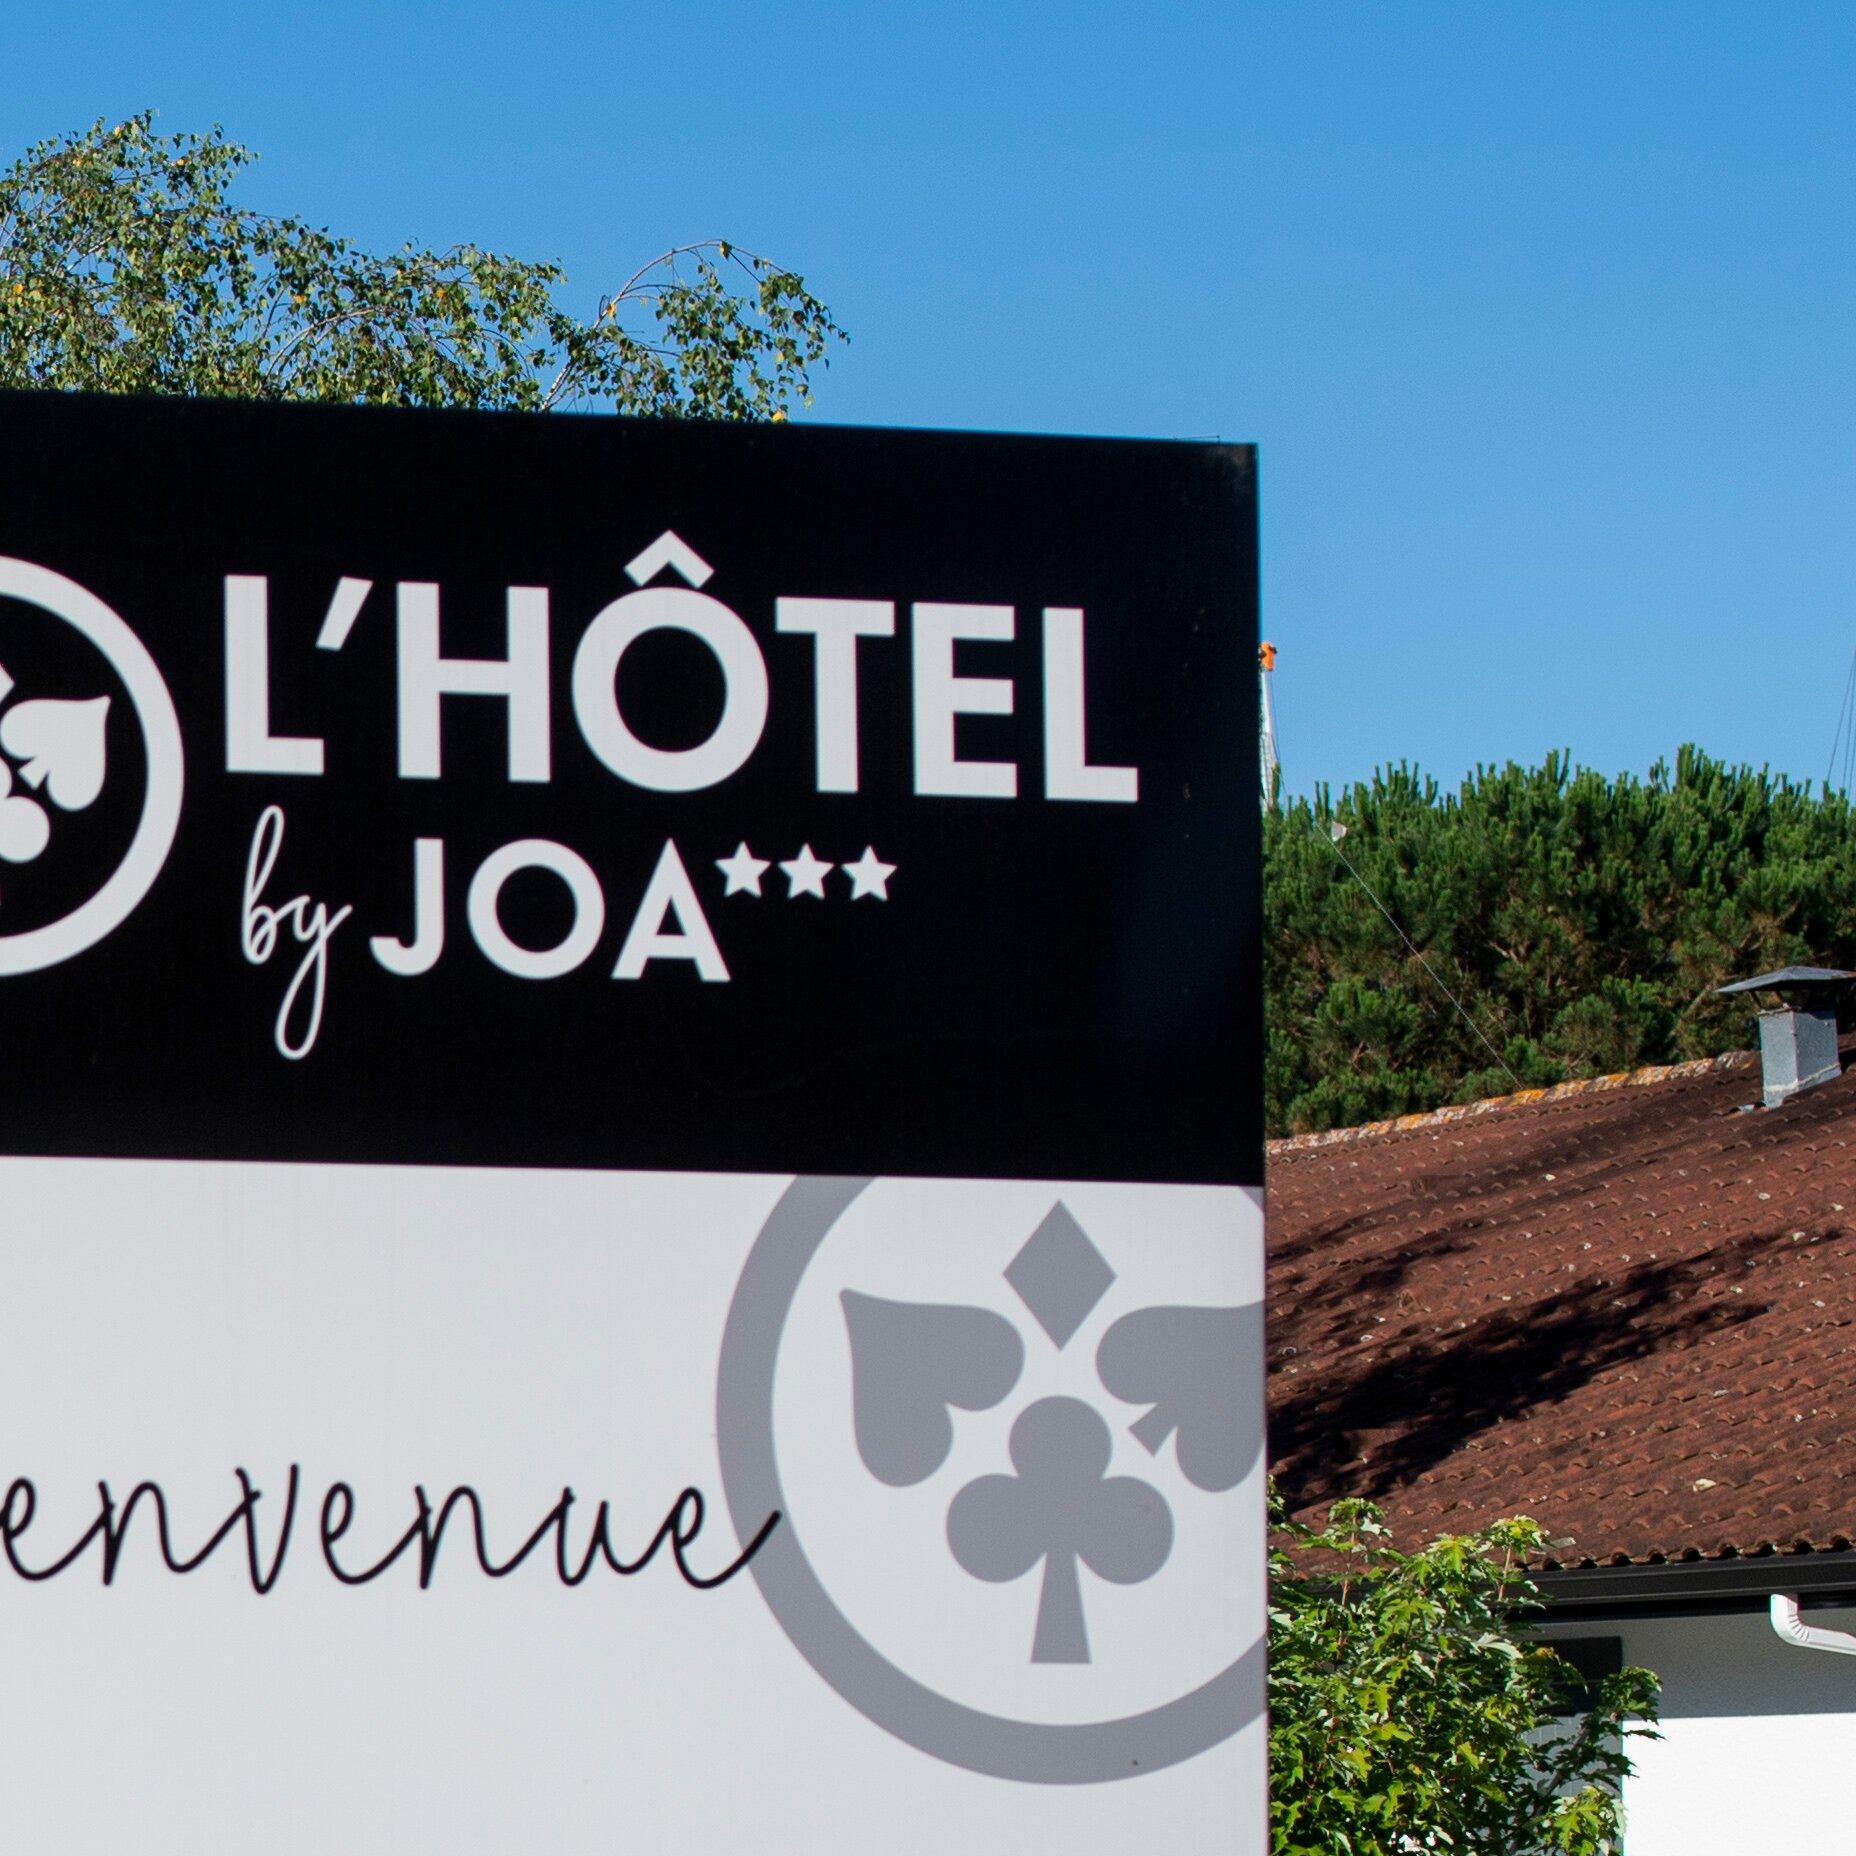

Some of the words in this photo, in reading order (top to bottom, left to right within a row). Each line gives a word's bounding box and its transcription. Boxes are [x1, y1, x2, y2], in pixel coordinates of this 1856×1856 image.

[224, 530, 1138, 803] L'HÔTEL
[242, 805, 353, 1060] by
[370, 838, 731, 982] JOA
